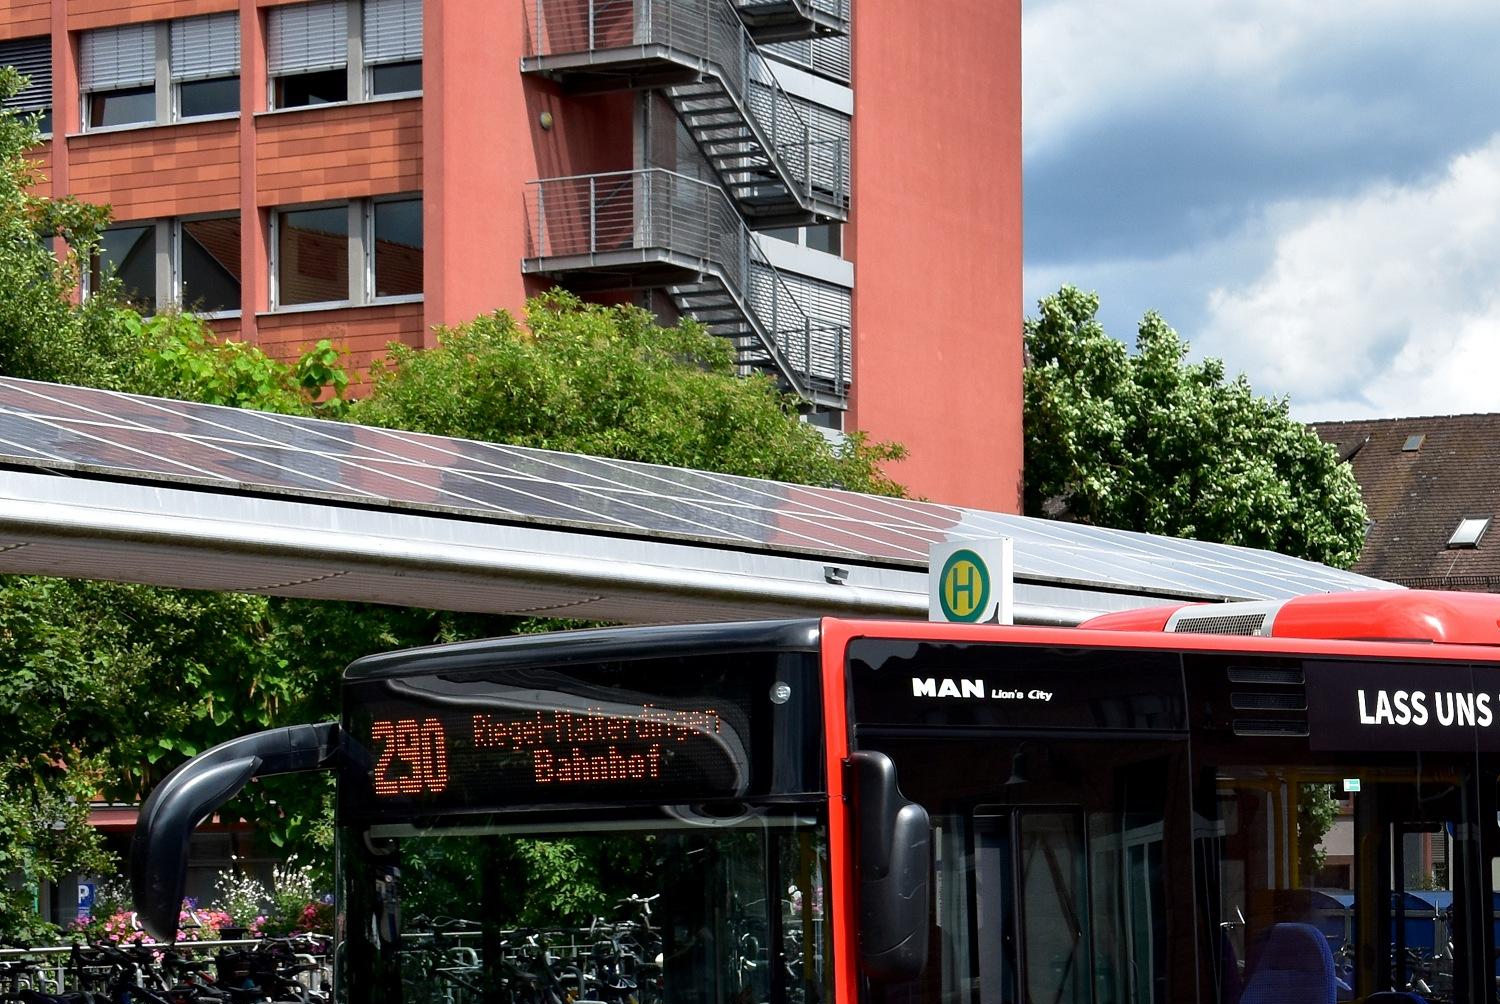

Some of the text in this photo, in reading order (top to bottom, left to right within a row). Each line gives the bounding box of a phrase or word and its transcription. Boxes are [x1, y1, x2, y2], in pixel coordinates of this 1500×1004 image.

[953, 565, 974, 611] H
[912, 677, 985, 699] MAN
[991, 688, 1053, 701] Lion's City
[1357, 689, 1429, 726] LASS
[1435, 692, 1493, 729] UNS
[371, 717, 448, 795] 290
[533, 743, 662, 784] Bahnhof
[78, 885, 90, 903] P
